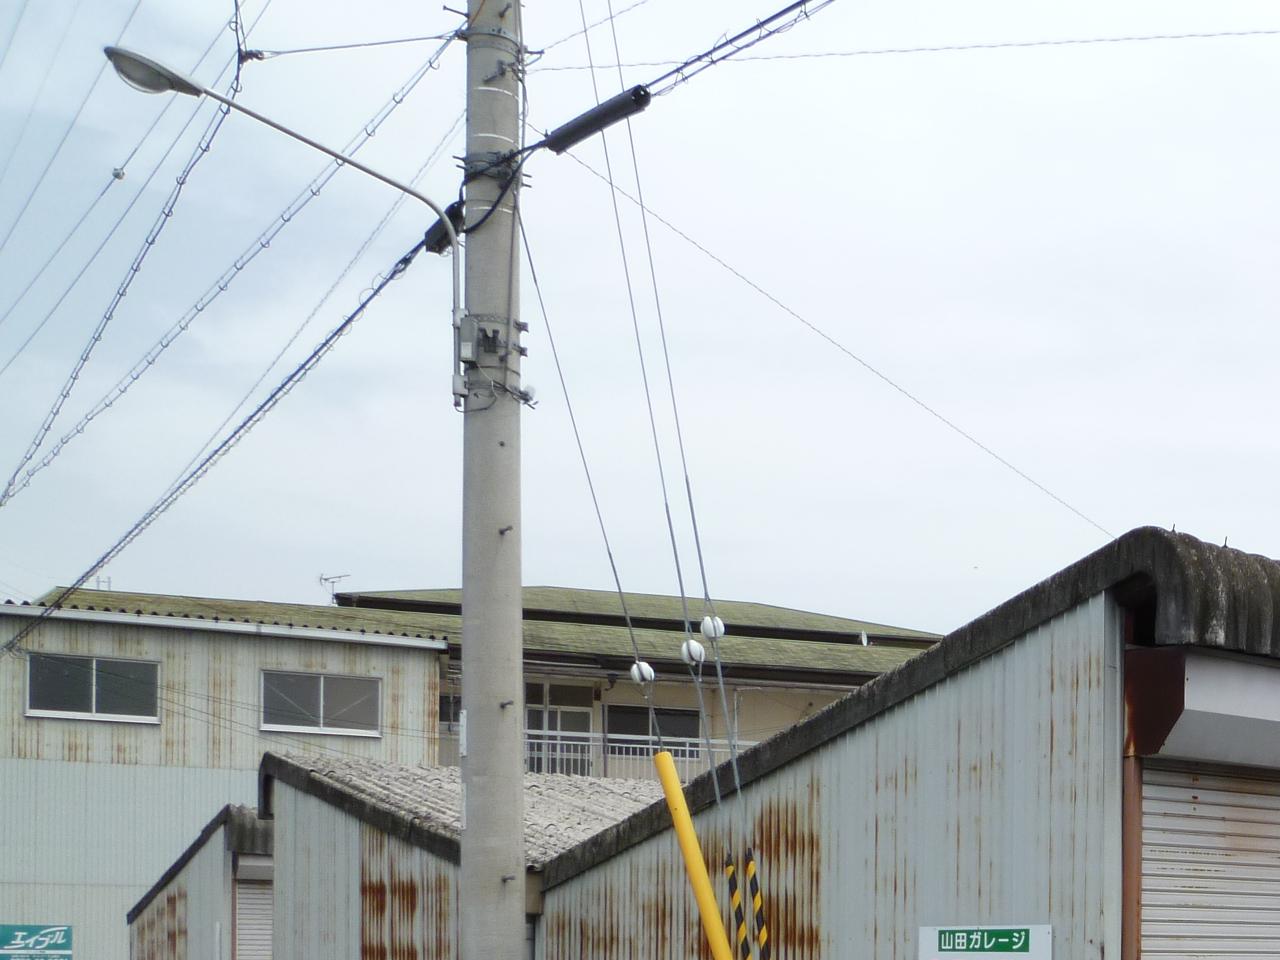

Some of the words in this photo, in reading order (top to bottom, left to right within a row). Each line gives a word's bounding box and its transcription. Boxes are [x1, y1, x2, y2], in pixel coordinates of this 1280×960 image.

[941, 931, 1026, 950] 山田ガレージ
